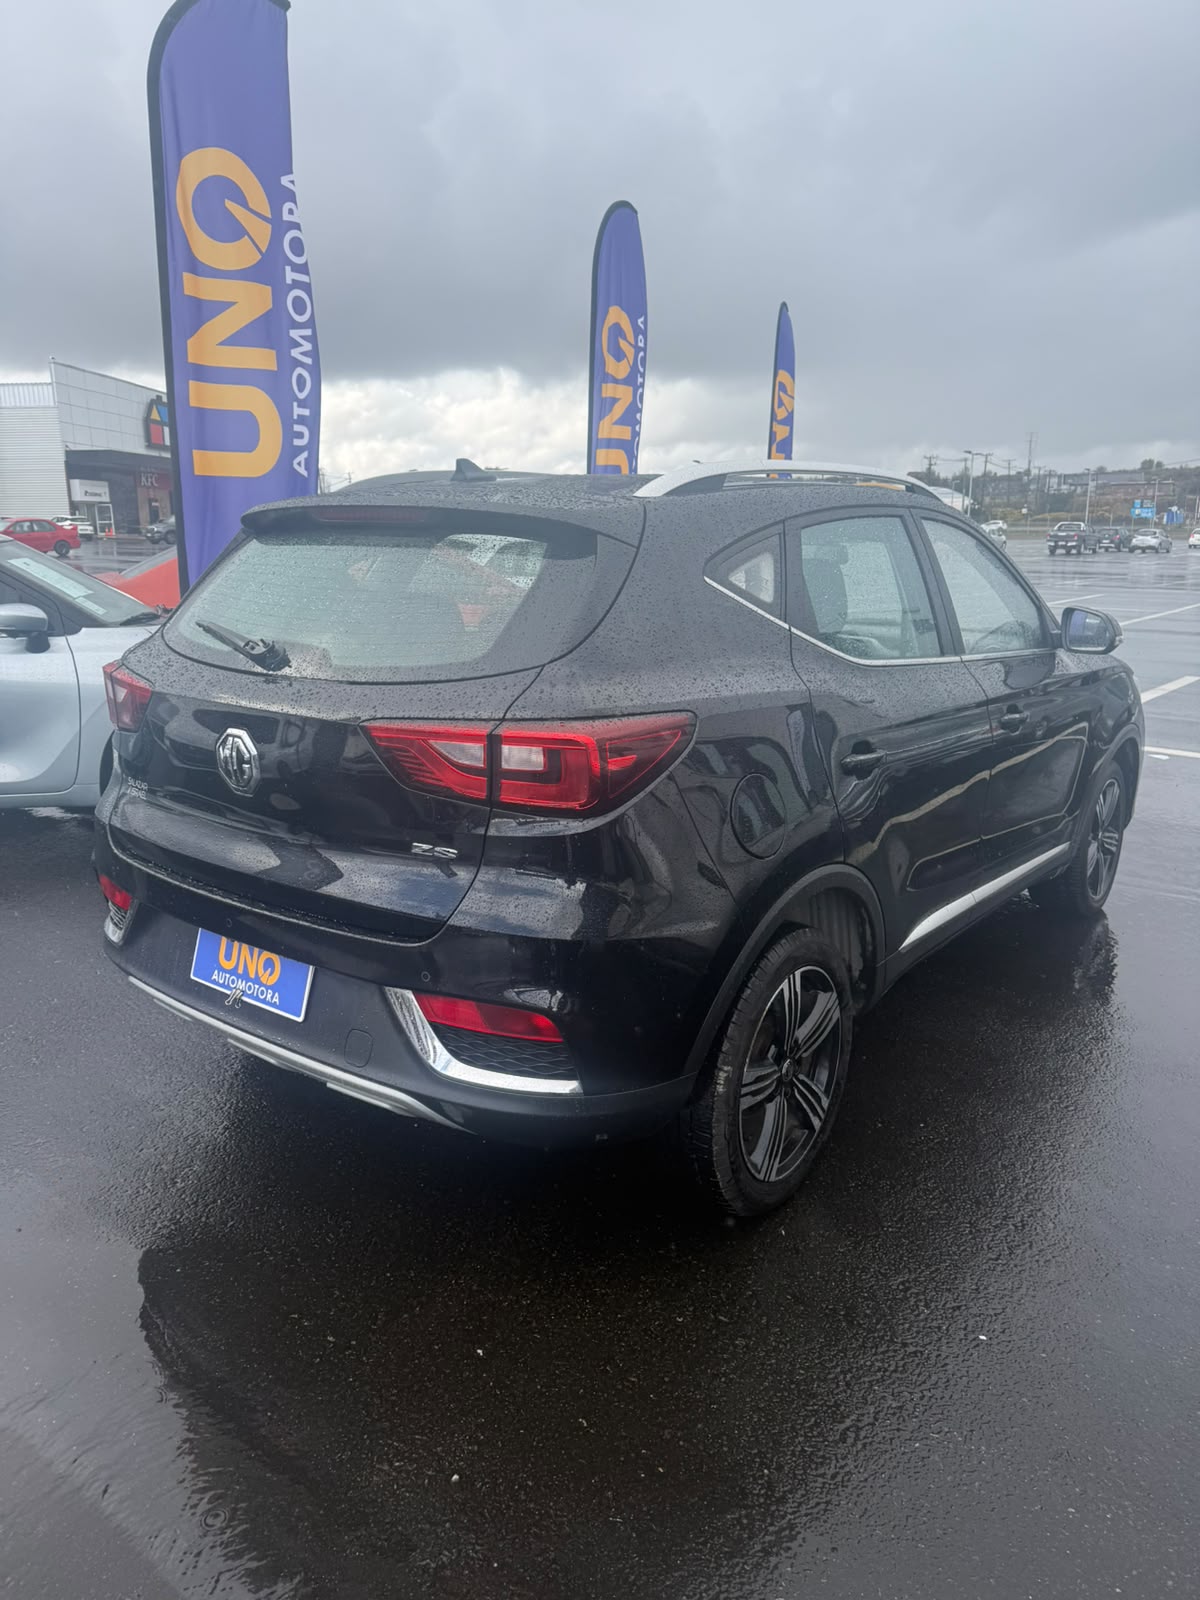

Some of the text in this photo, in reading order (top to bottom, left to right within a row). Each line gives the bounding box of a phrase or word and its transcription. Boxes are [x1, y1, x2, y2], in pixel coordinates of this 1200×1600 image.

[176, 147, 283, 477] UNO
[281, 173, 313, 478] AUTOMOTORA
[141, 473, 158, 486] KFC
[218, 734, 254, 789] MG
[411, 842, 458, 859] ZS
[219, 936, 281, 986] UNO
[211, 969, 280, 1005] AUTOMOTORA
